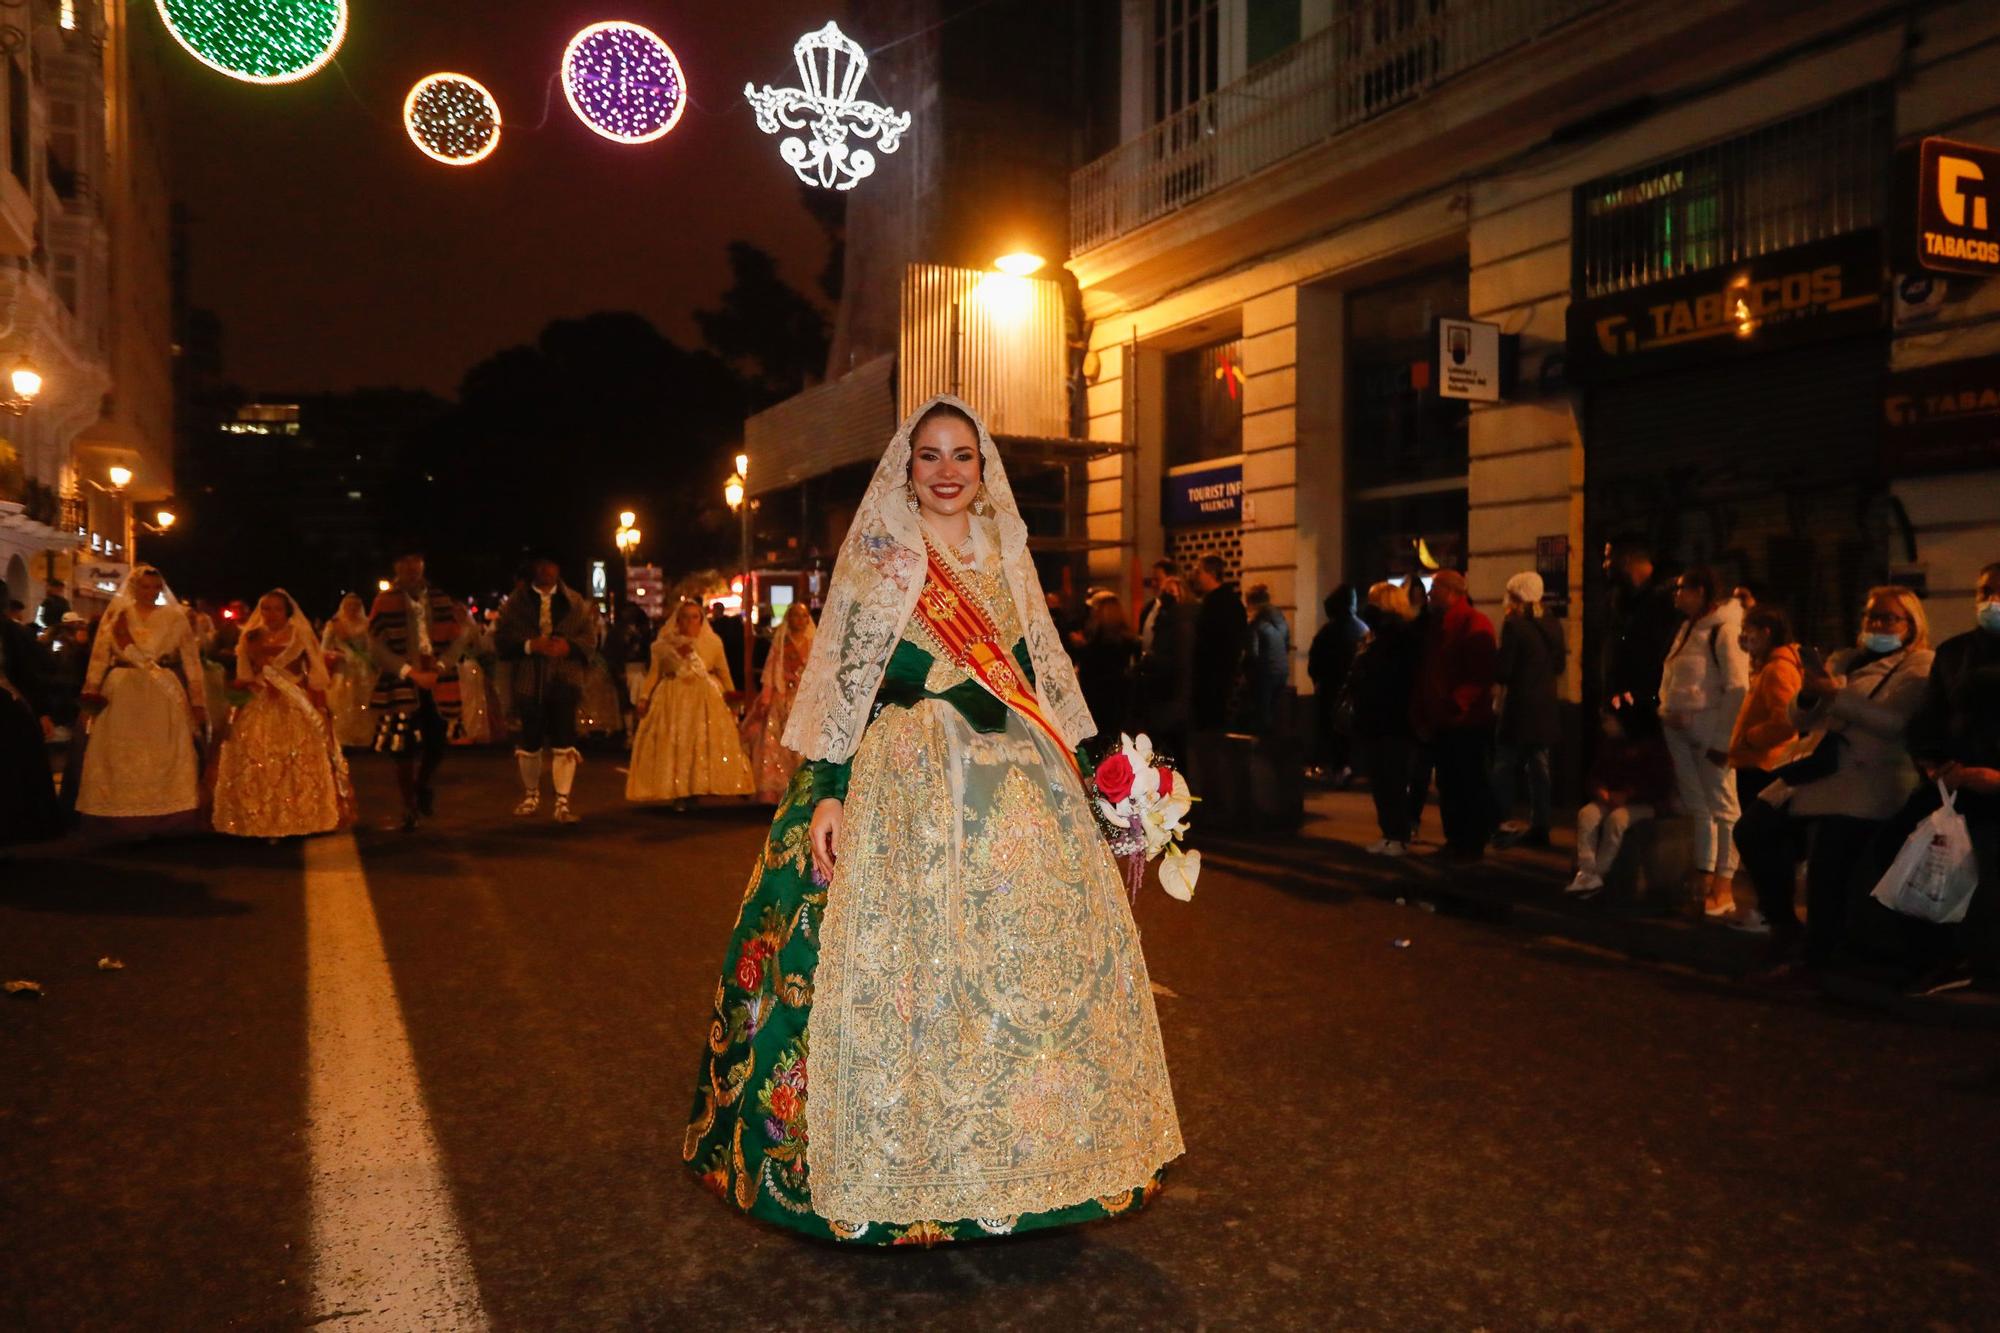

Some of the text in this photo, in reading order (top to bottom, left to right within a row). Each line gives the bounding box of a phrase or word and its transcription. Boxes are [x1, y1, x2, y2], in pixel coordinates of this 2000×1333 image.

[1924, 231, 1999, 264] TABACOS
[1647, 263, 1842, 338] TABACOS
[1924, 388, 2000, 416] TABA
[1187, 483, 1225, 504] TOURIST
